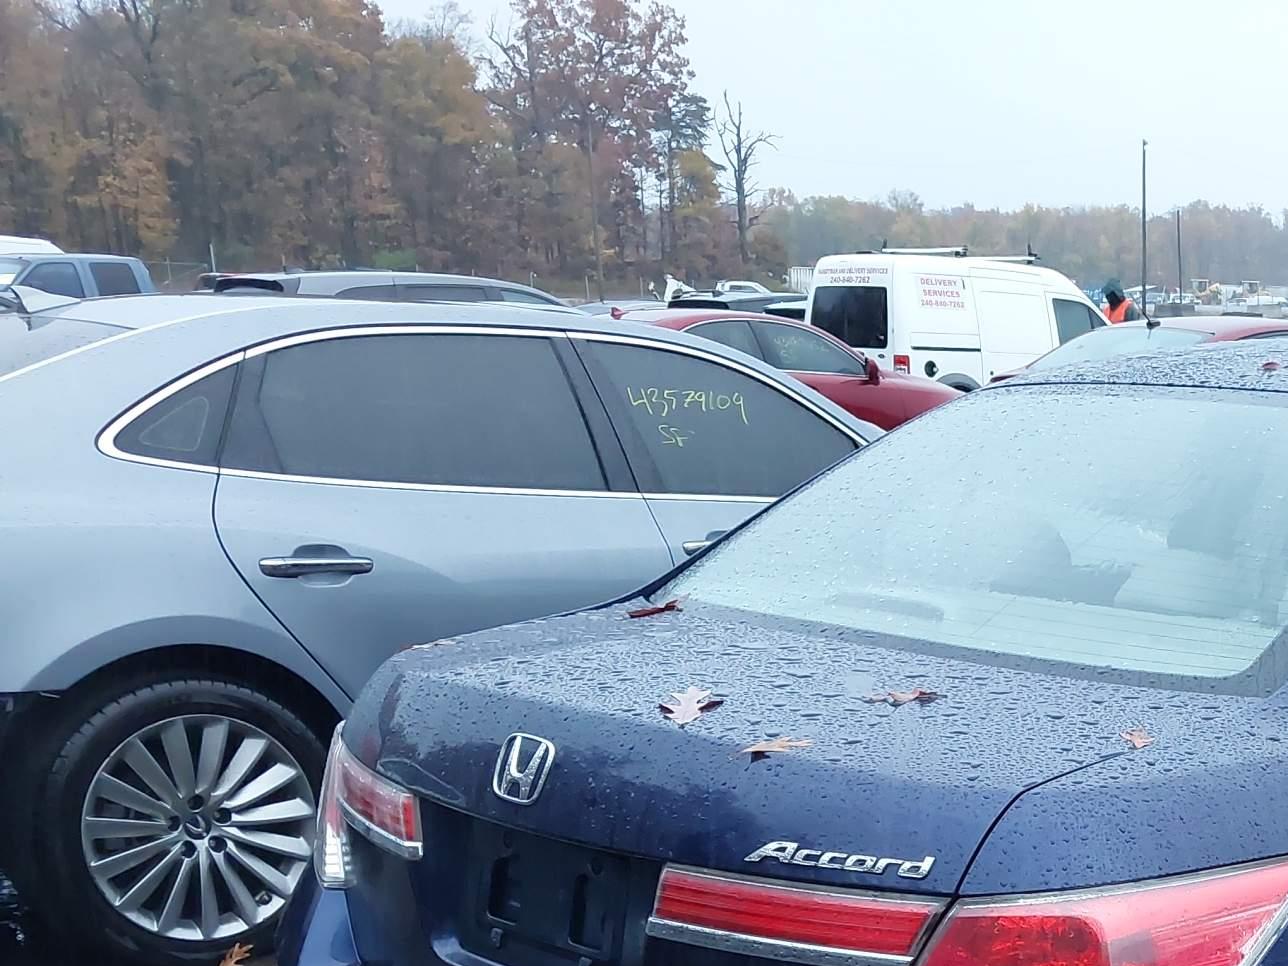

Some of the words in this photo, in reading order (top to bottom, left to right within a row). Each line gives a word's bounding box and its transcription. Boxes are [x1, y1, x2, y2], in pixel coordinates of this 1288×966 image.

[920, 277, 957, 287] DELIVERY
[922, 289, 960, 298] SERVICES
[744, 841, 936, 879] Accord
